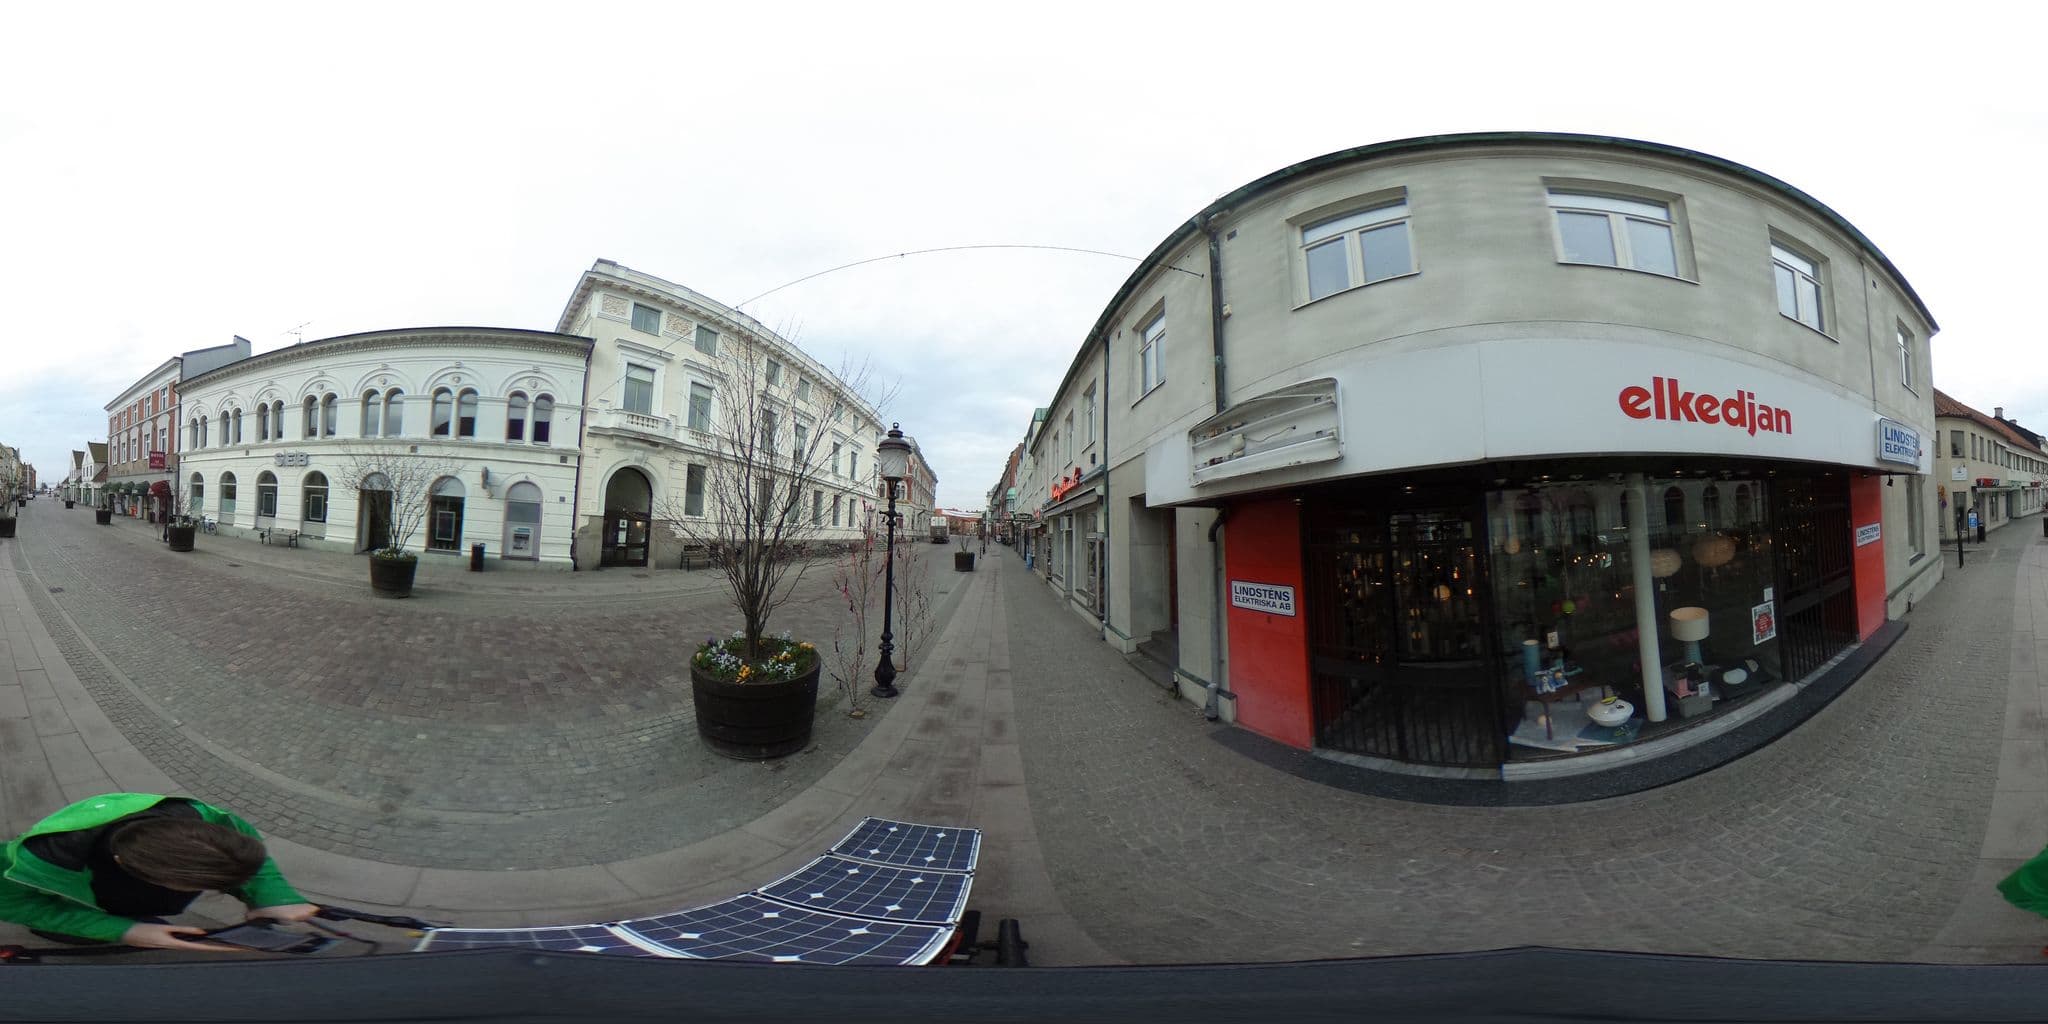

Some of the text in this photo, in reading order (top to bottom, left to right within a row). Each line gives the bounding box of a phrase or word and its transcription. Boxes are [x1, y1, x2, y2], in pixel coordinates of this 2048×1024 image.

[1618, 376, 1792, 437] elkedjan
[275, 452, 308, 467] SEB
[1234, 585, 1290, 601] LINDSTÉNS
[1234, 595, 1291, 611] ELEKTRISKA AB
